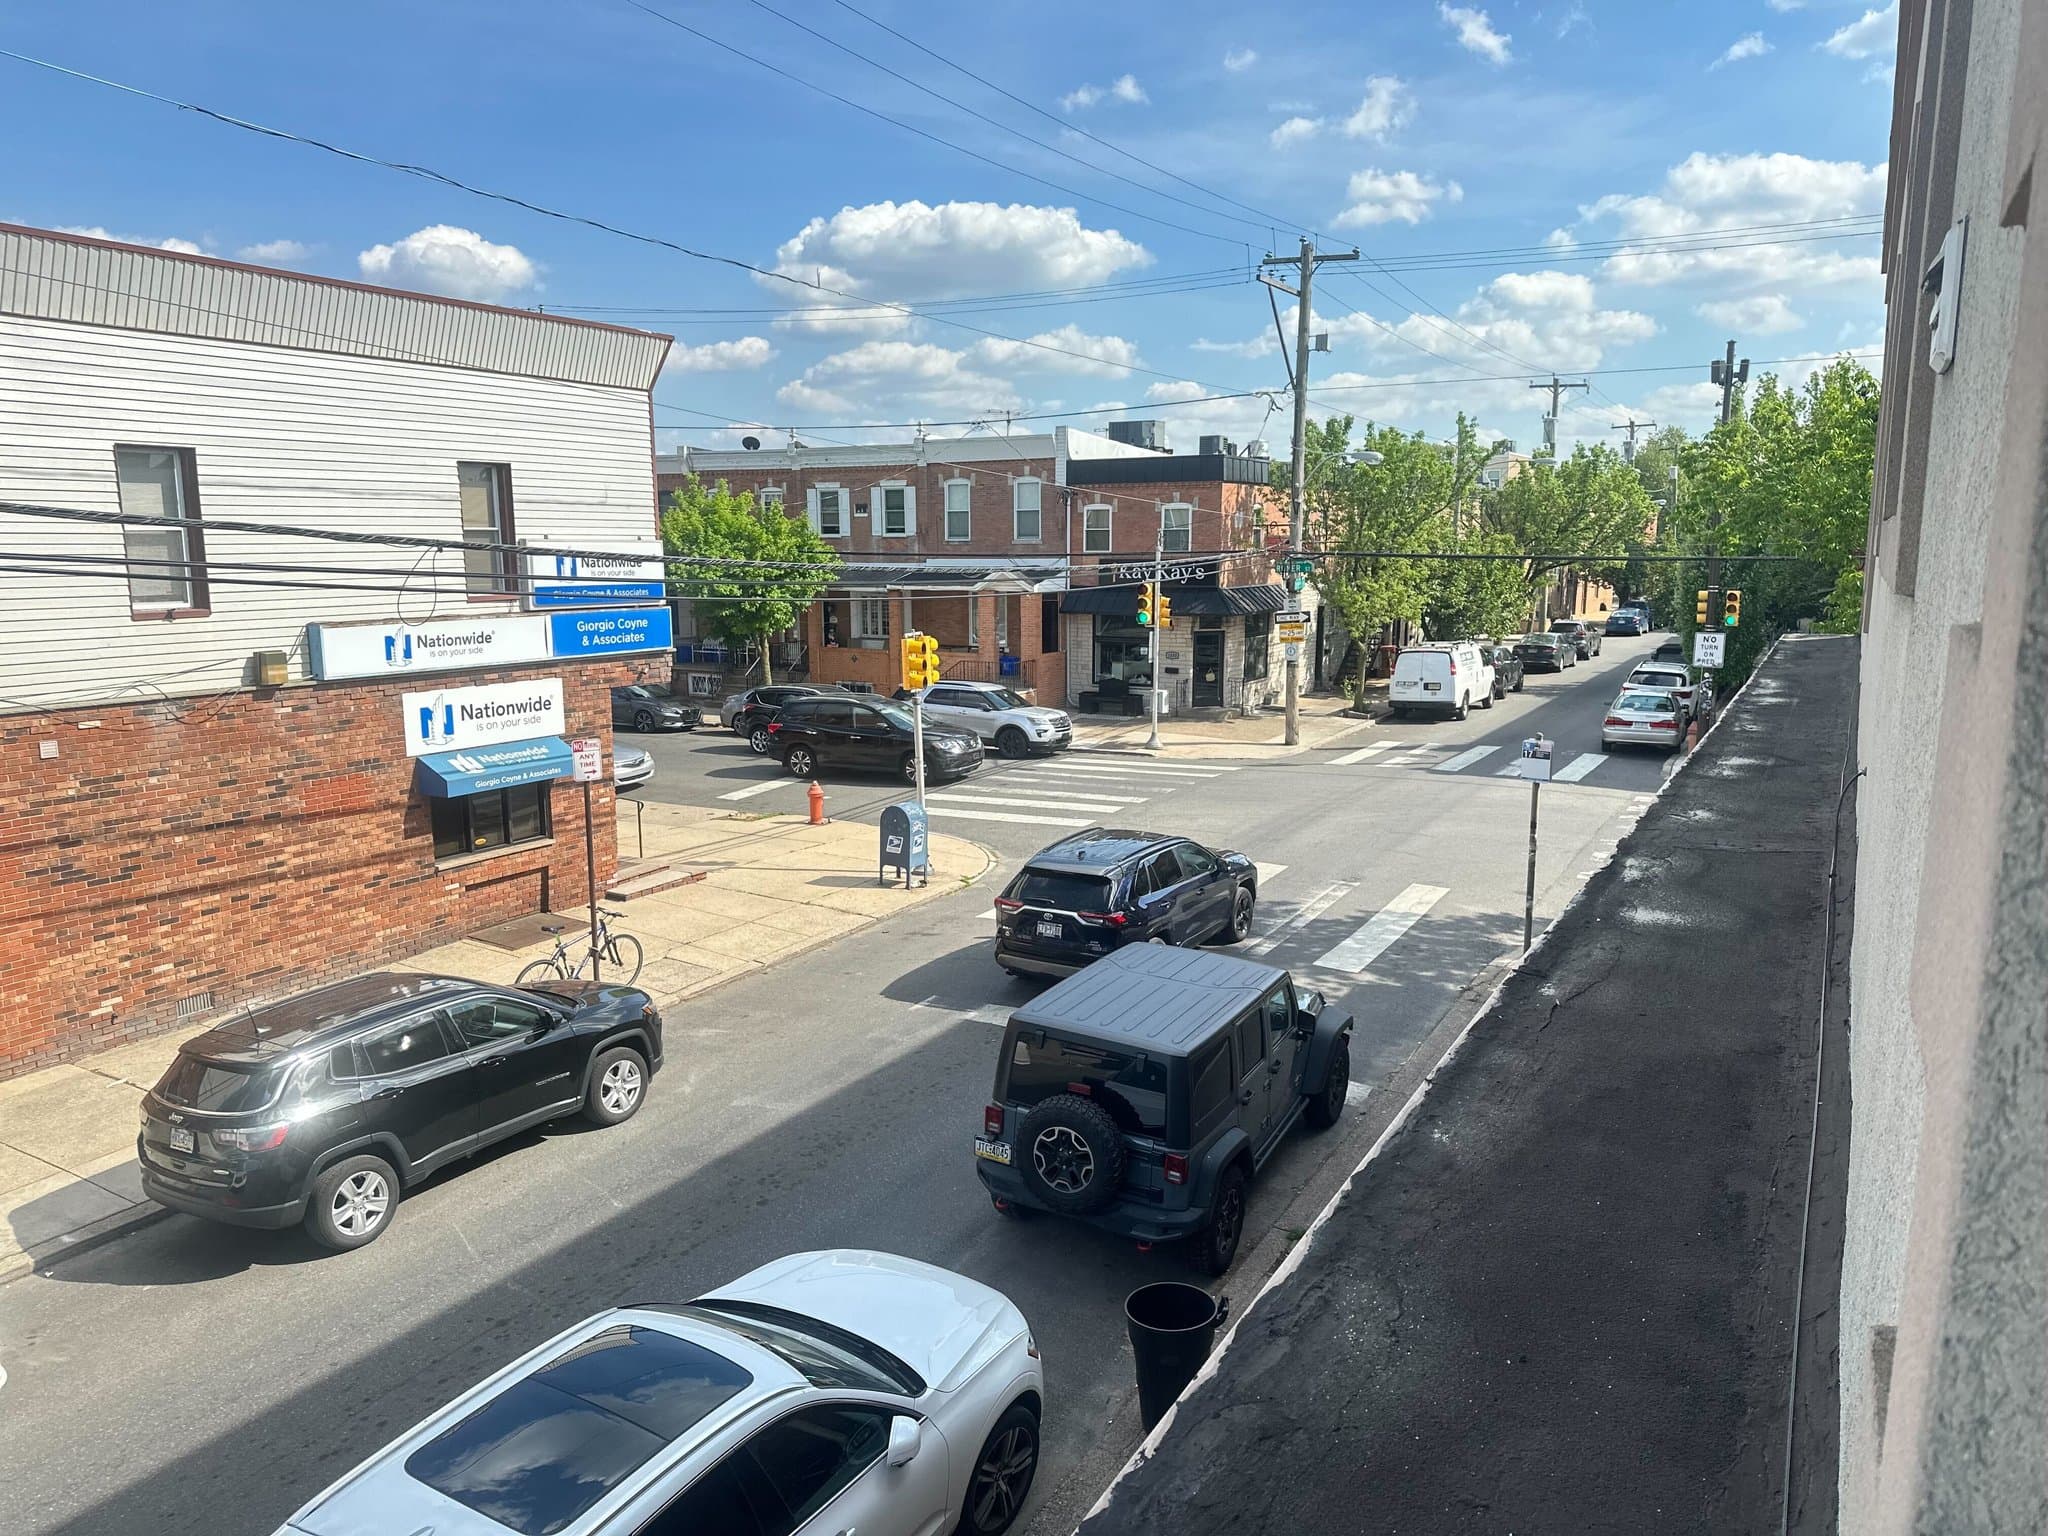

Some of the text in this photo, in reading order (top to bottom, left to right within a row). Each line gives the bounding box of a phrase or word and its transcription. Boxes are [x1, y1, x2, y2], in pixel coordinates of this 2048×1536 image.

[581, 556, 643, 569] Nationwide
[622, 568, 635, 577] side
[613, 588, 649, 597] Associates
[577, 617, 649, 633] Giorgio Coyne
[417, 631, 493, 648] Nationwide
[582, 632, 645, 646] & Associates
[438, 649, 448, 657] on
[449, 648, 467, 658] your
[468, 646, 484, 654] side
[460, 696, 552, 721] Nationwide
[476, 715, 542, 732] is on your side
[574, 741, 583, 751] NO
[475, 777, 501, 789] Giorgio
[501, 775, 522, 785] Coyne
[529, 767, 562, 779] Associates
